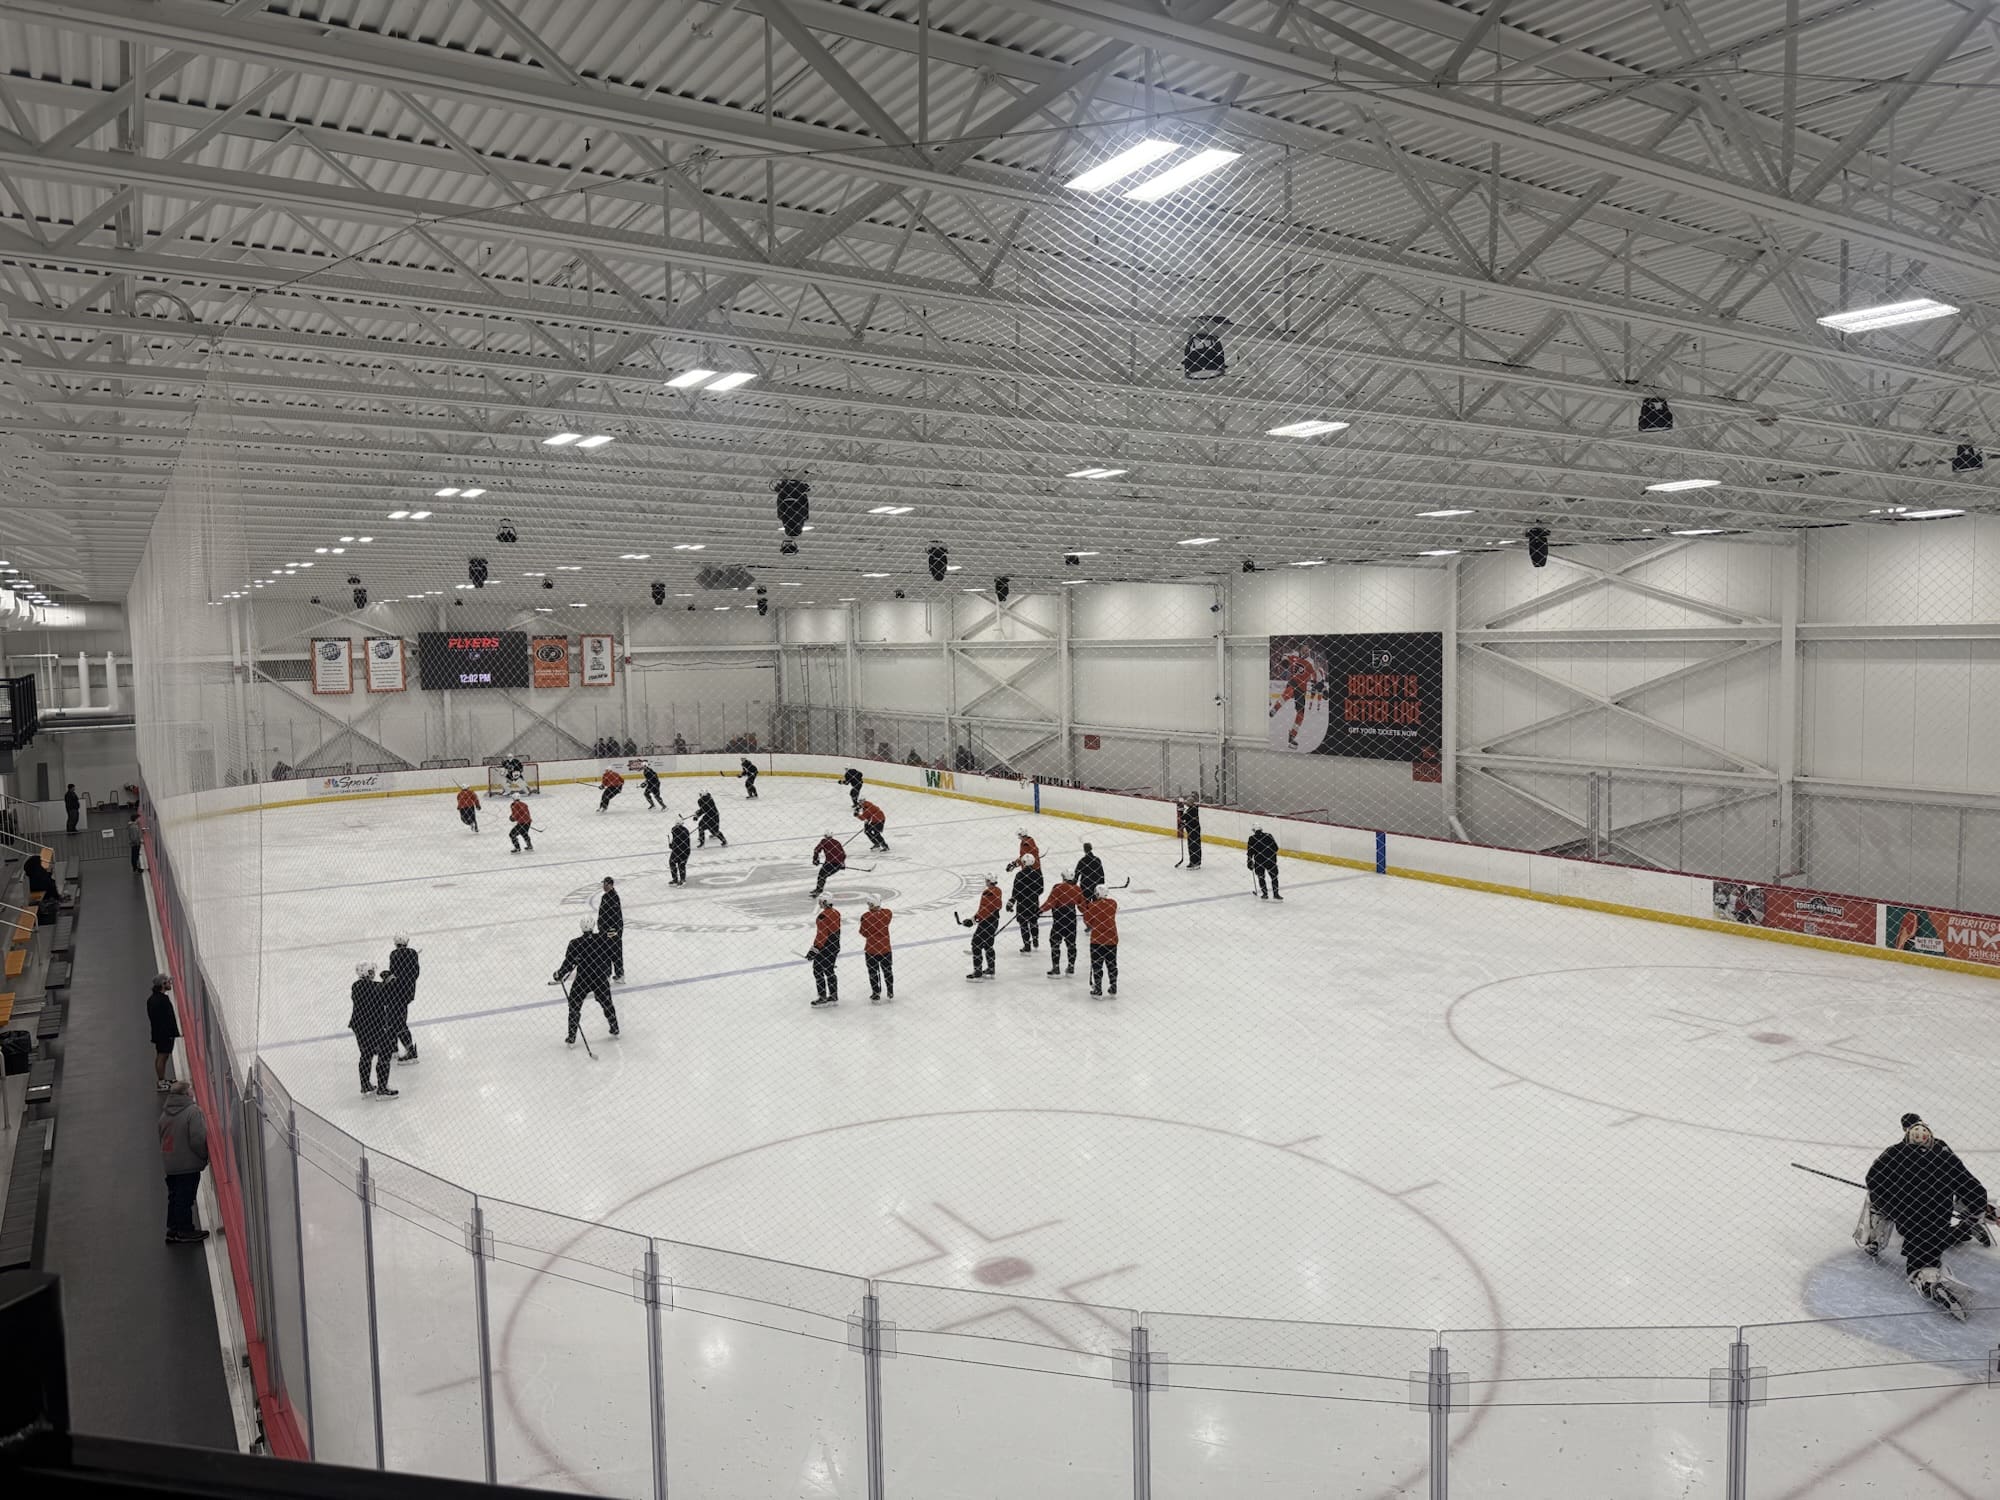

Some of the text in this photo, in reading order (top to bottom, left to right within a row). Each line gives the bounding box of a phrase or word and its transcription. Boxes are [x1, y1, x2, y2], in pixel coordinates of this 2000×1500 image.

[448, 637, 499, 648] FLYERS
[460, 673, 491, 683] 12:02 PM
[1348, 674, 1417, 697] HOCKEY IS
[1344, 699, 1389, 722] BETTER
[1360, 727, 1376, 735] YOUR
[1377, 728, 1401, 736] TICKETS
[339, 776, 378, 789] Sports
[925, 769, 955, 790] WM
[1948, 916, 1996, 931] BURRITOS
[1947, 926, 2000, 950] MIX
